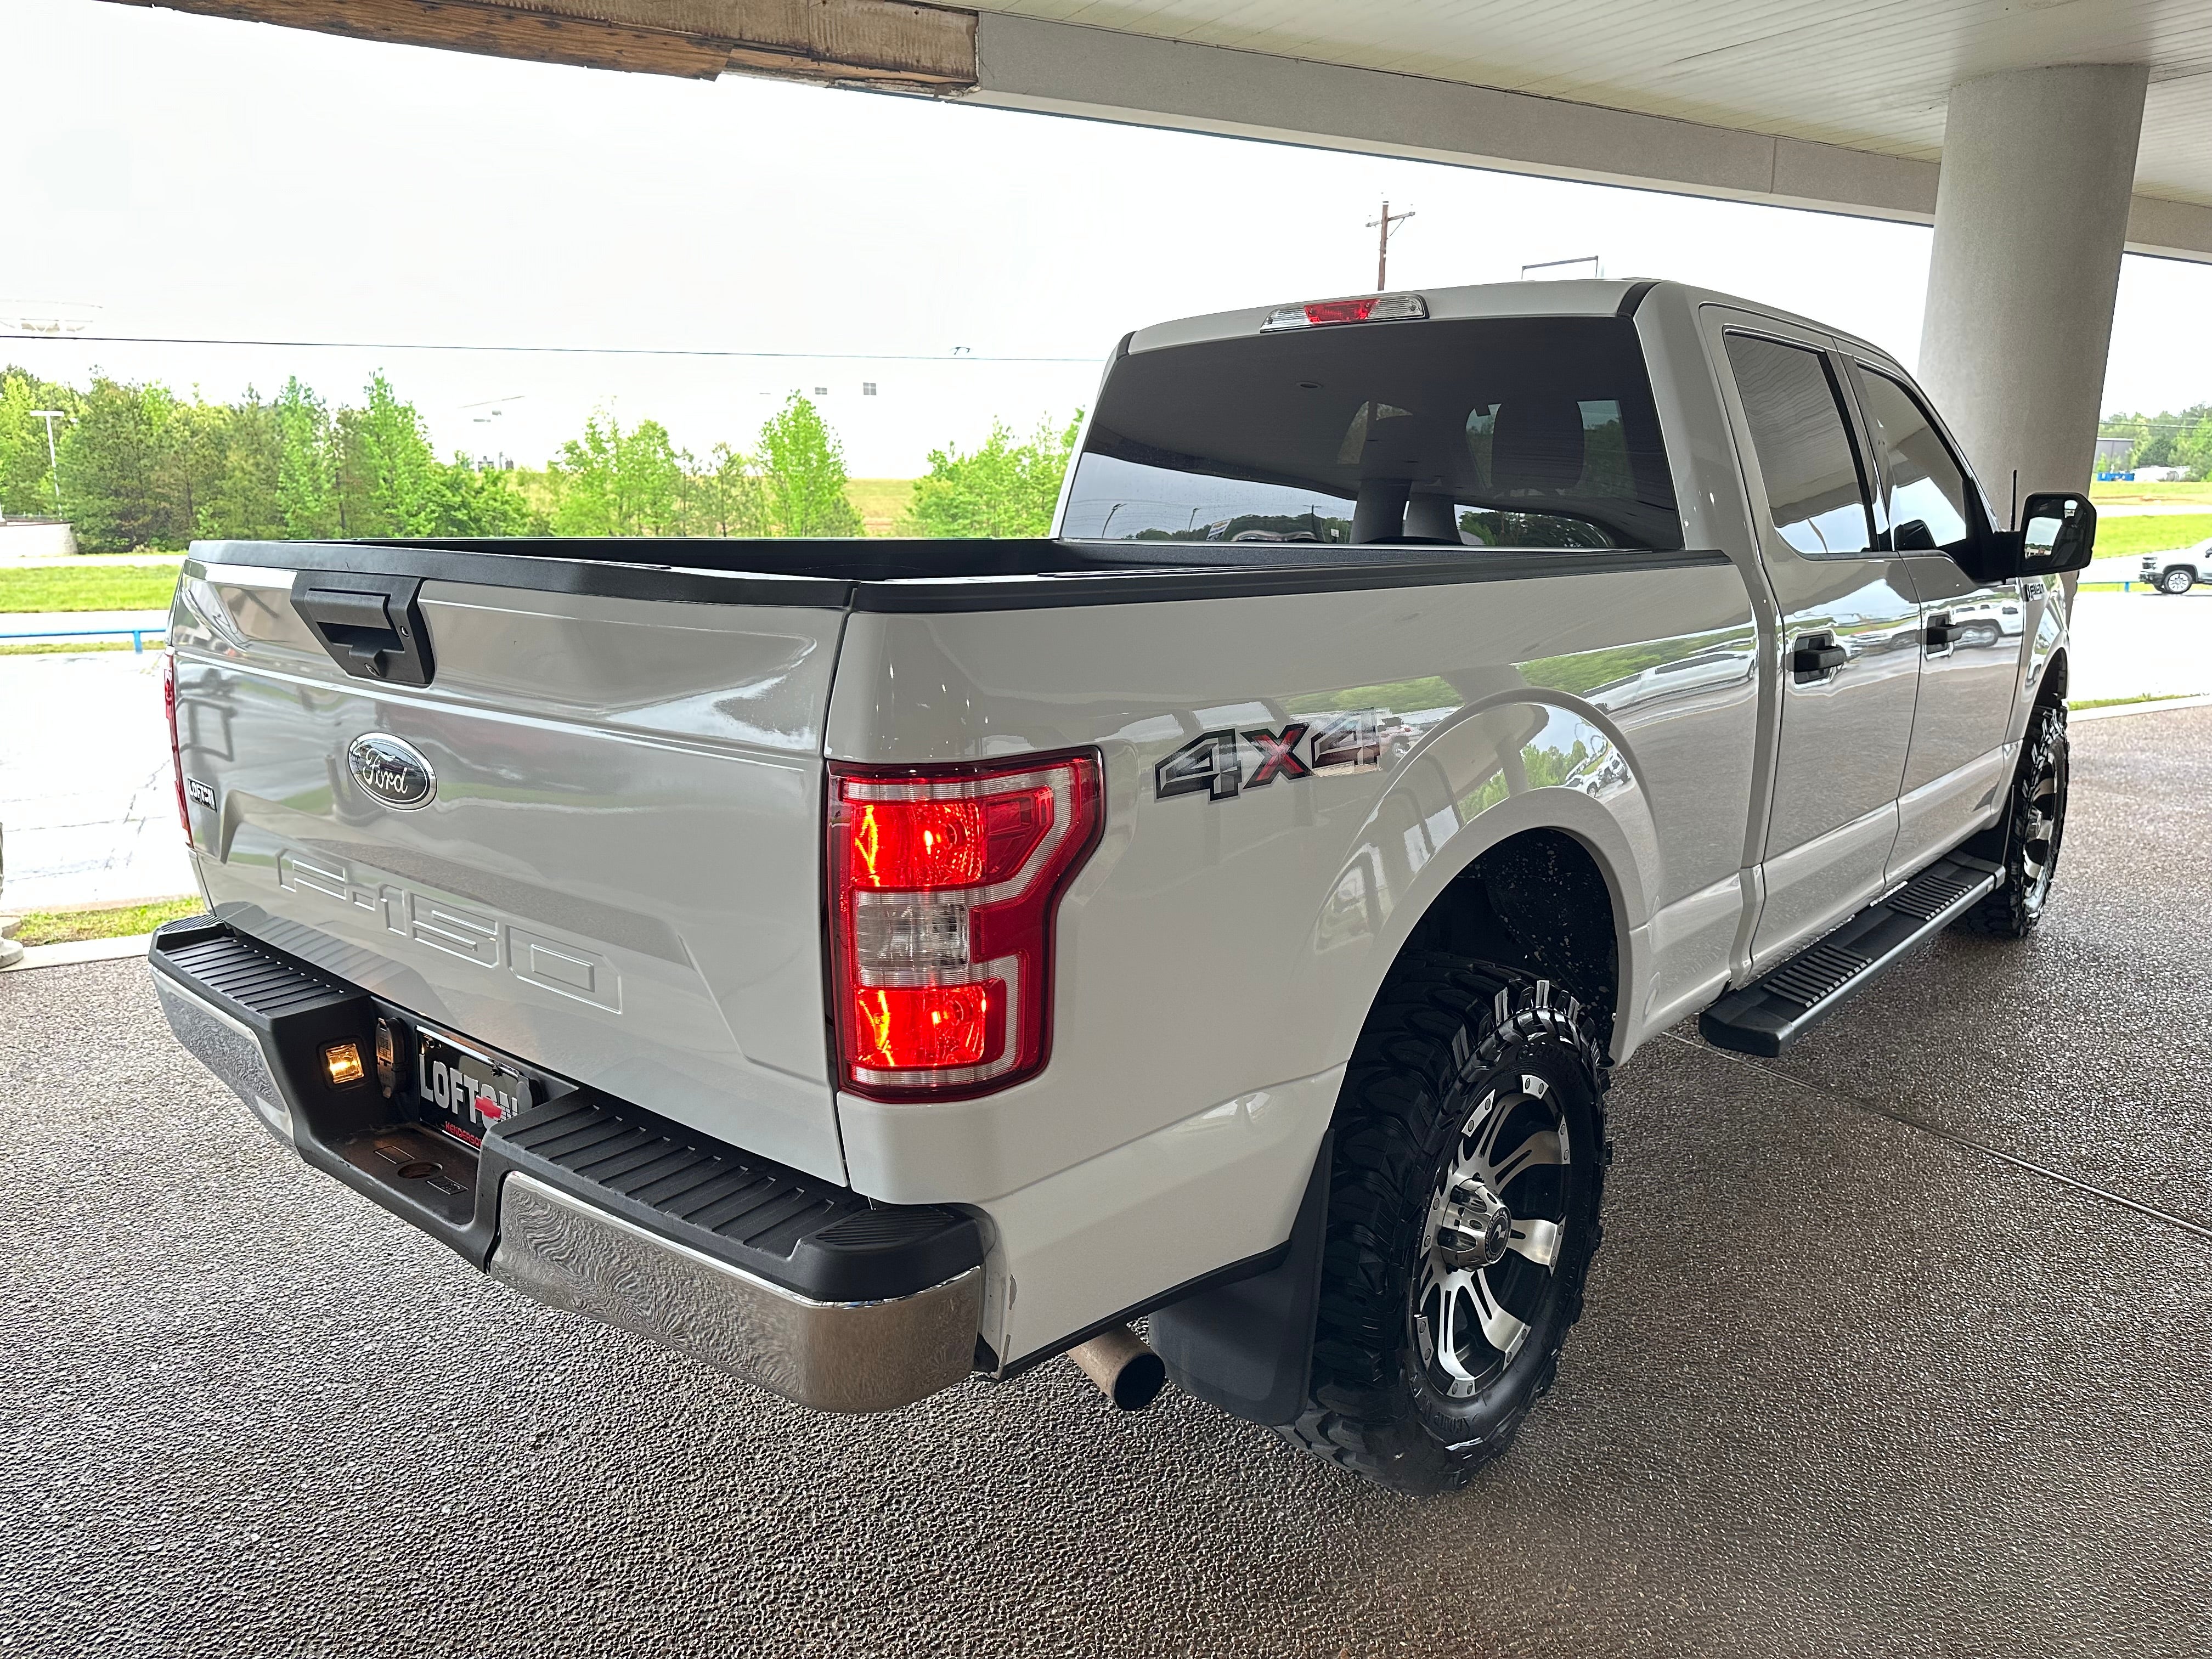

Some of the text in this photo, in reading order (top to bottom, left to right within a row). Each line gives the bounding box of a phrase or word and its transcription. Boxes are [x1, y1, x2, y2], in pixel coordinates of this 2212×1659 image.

[188, 780, 215, 805] LOFTON
[363, 748, 408, 794] Ford
[276, 849, 622, 1014] F-150
